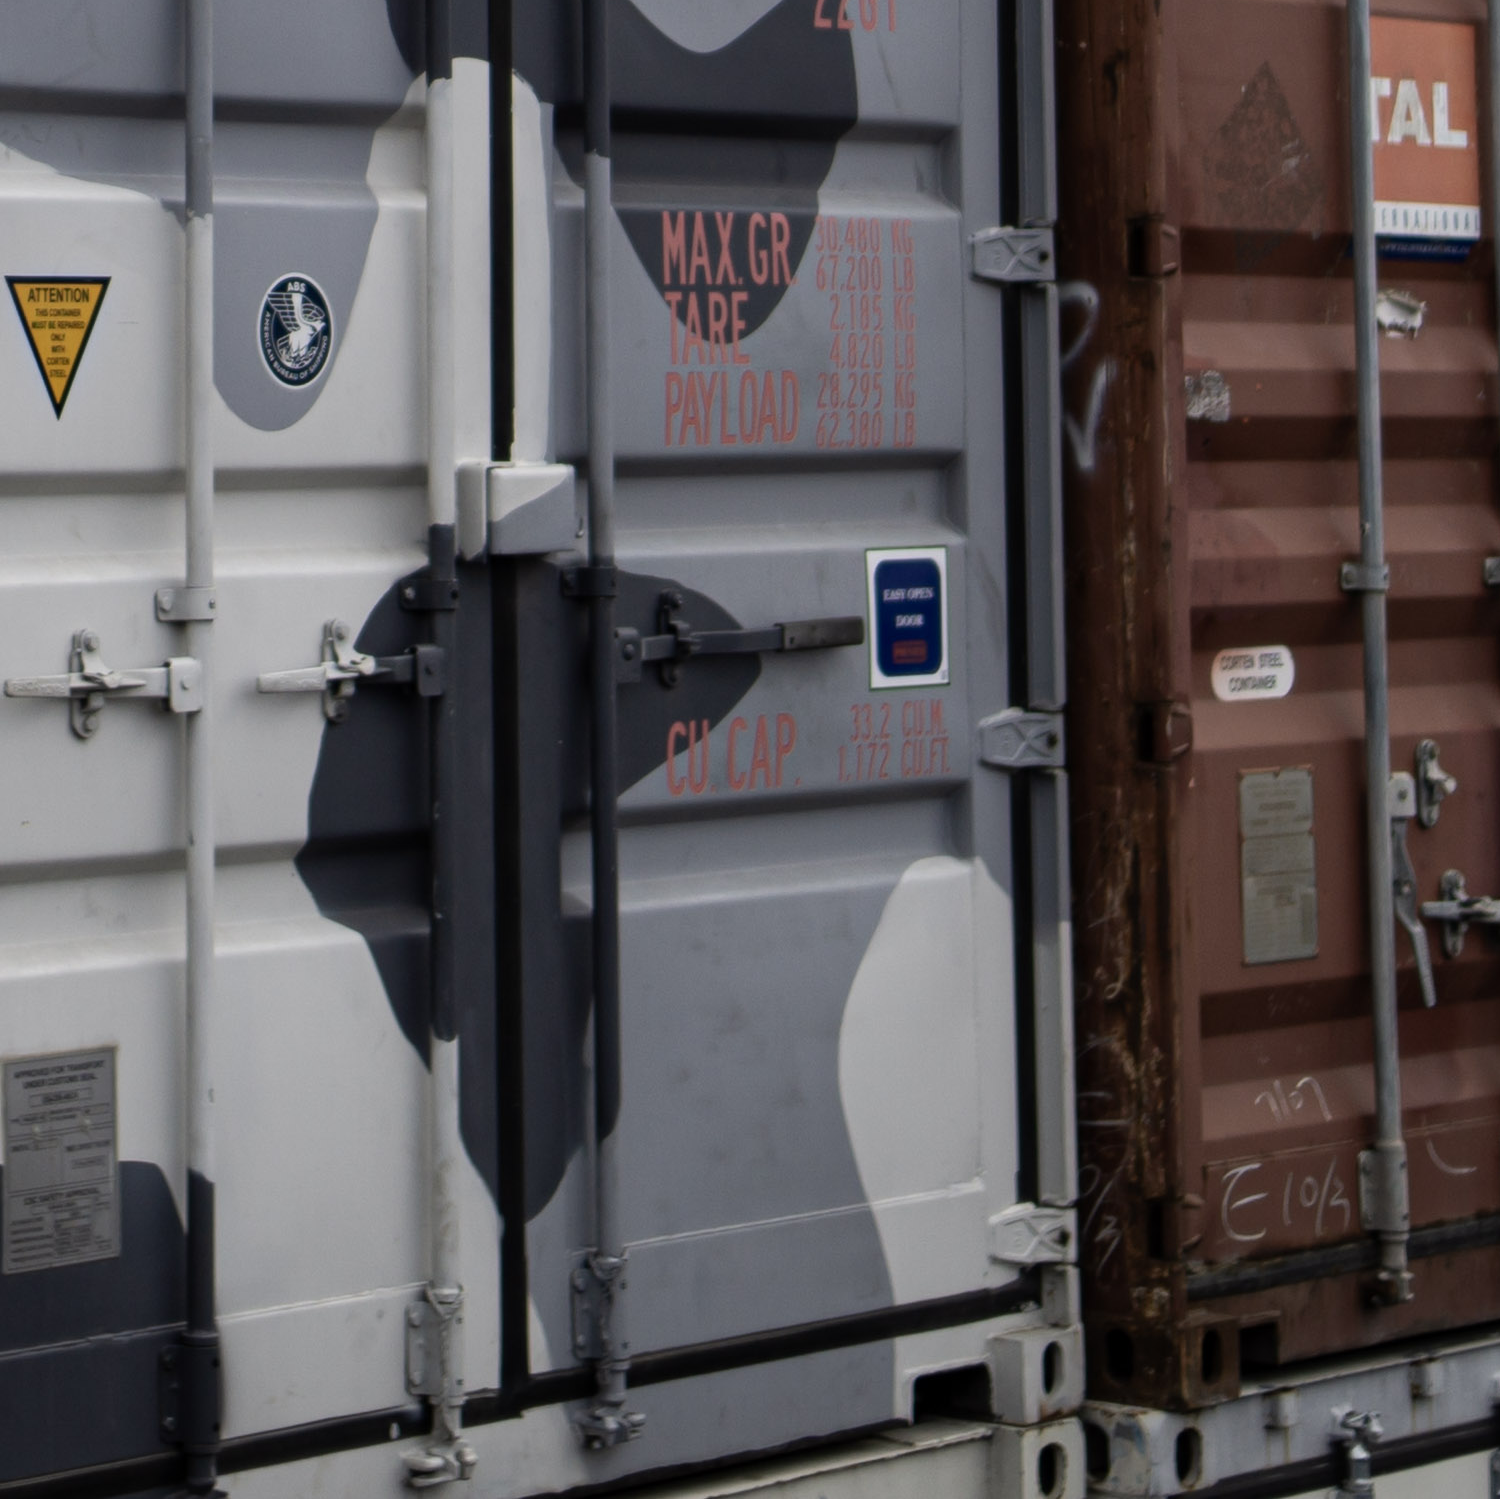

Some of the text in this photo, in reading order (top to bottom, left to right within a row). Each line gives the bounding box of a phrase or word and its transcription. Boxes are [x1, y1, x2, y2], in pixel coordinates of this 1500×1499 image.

[1381, 206, 1480, 232] ERNATIONAL
[891, 219, 914, 254] KG
[893, 257, 914, 292] LB
[287, 281, 306, 293] ABS
[27, 287, 90, 303] ATTENTION
[50, 308, 81, 317] CONTAINER
[48, 321, 56, 329] BE
[58, 320, 85, 329] REPAIRED
[664, 291, 749, 365] TARE
[894, 294, 915, 331] KG
[50, 333, 65, 341] ONLY
[51, 345, 65, 353] WITH
[895, 334, 915, 369] LB
[46, 357, 70, 365] CORTEN
[49, 369, 67, 378] STEEL
[664, 370, 799, 447] PAYLOAD
[894, 372, 915, 408] KG
[893, 412, 915, 448] LB
[883, 587, 934, 602] EASY OPEN
[895, 615, 924, 628] DOOR
